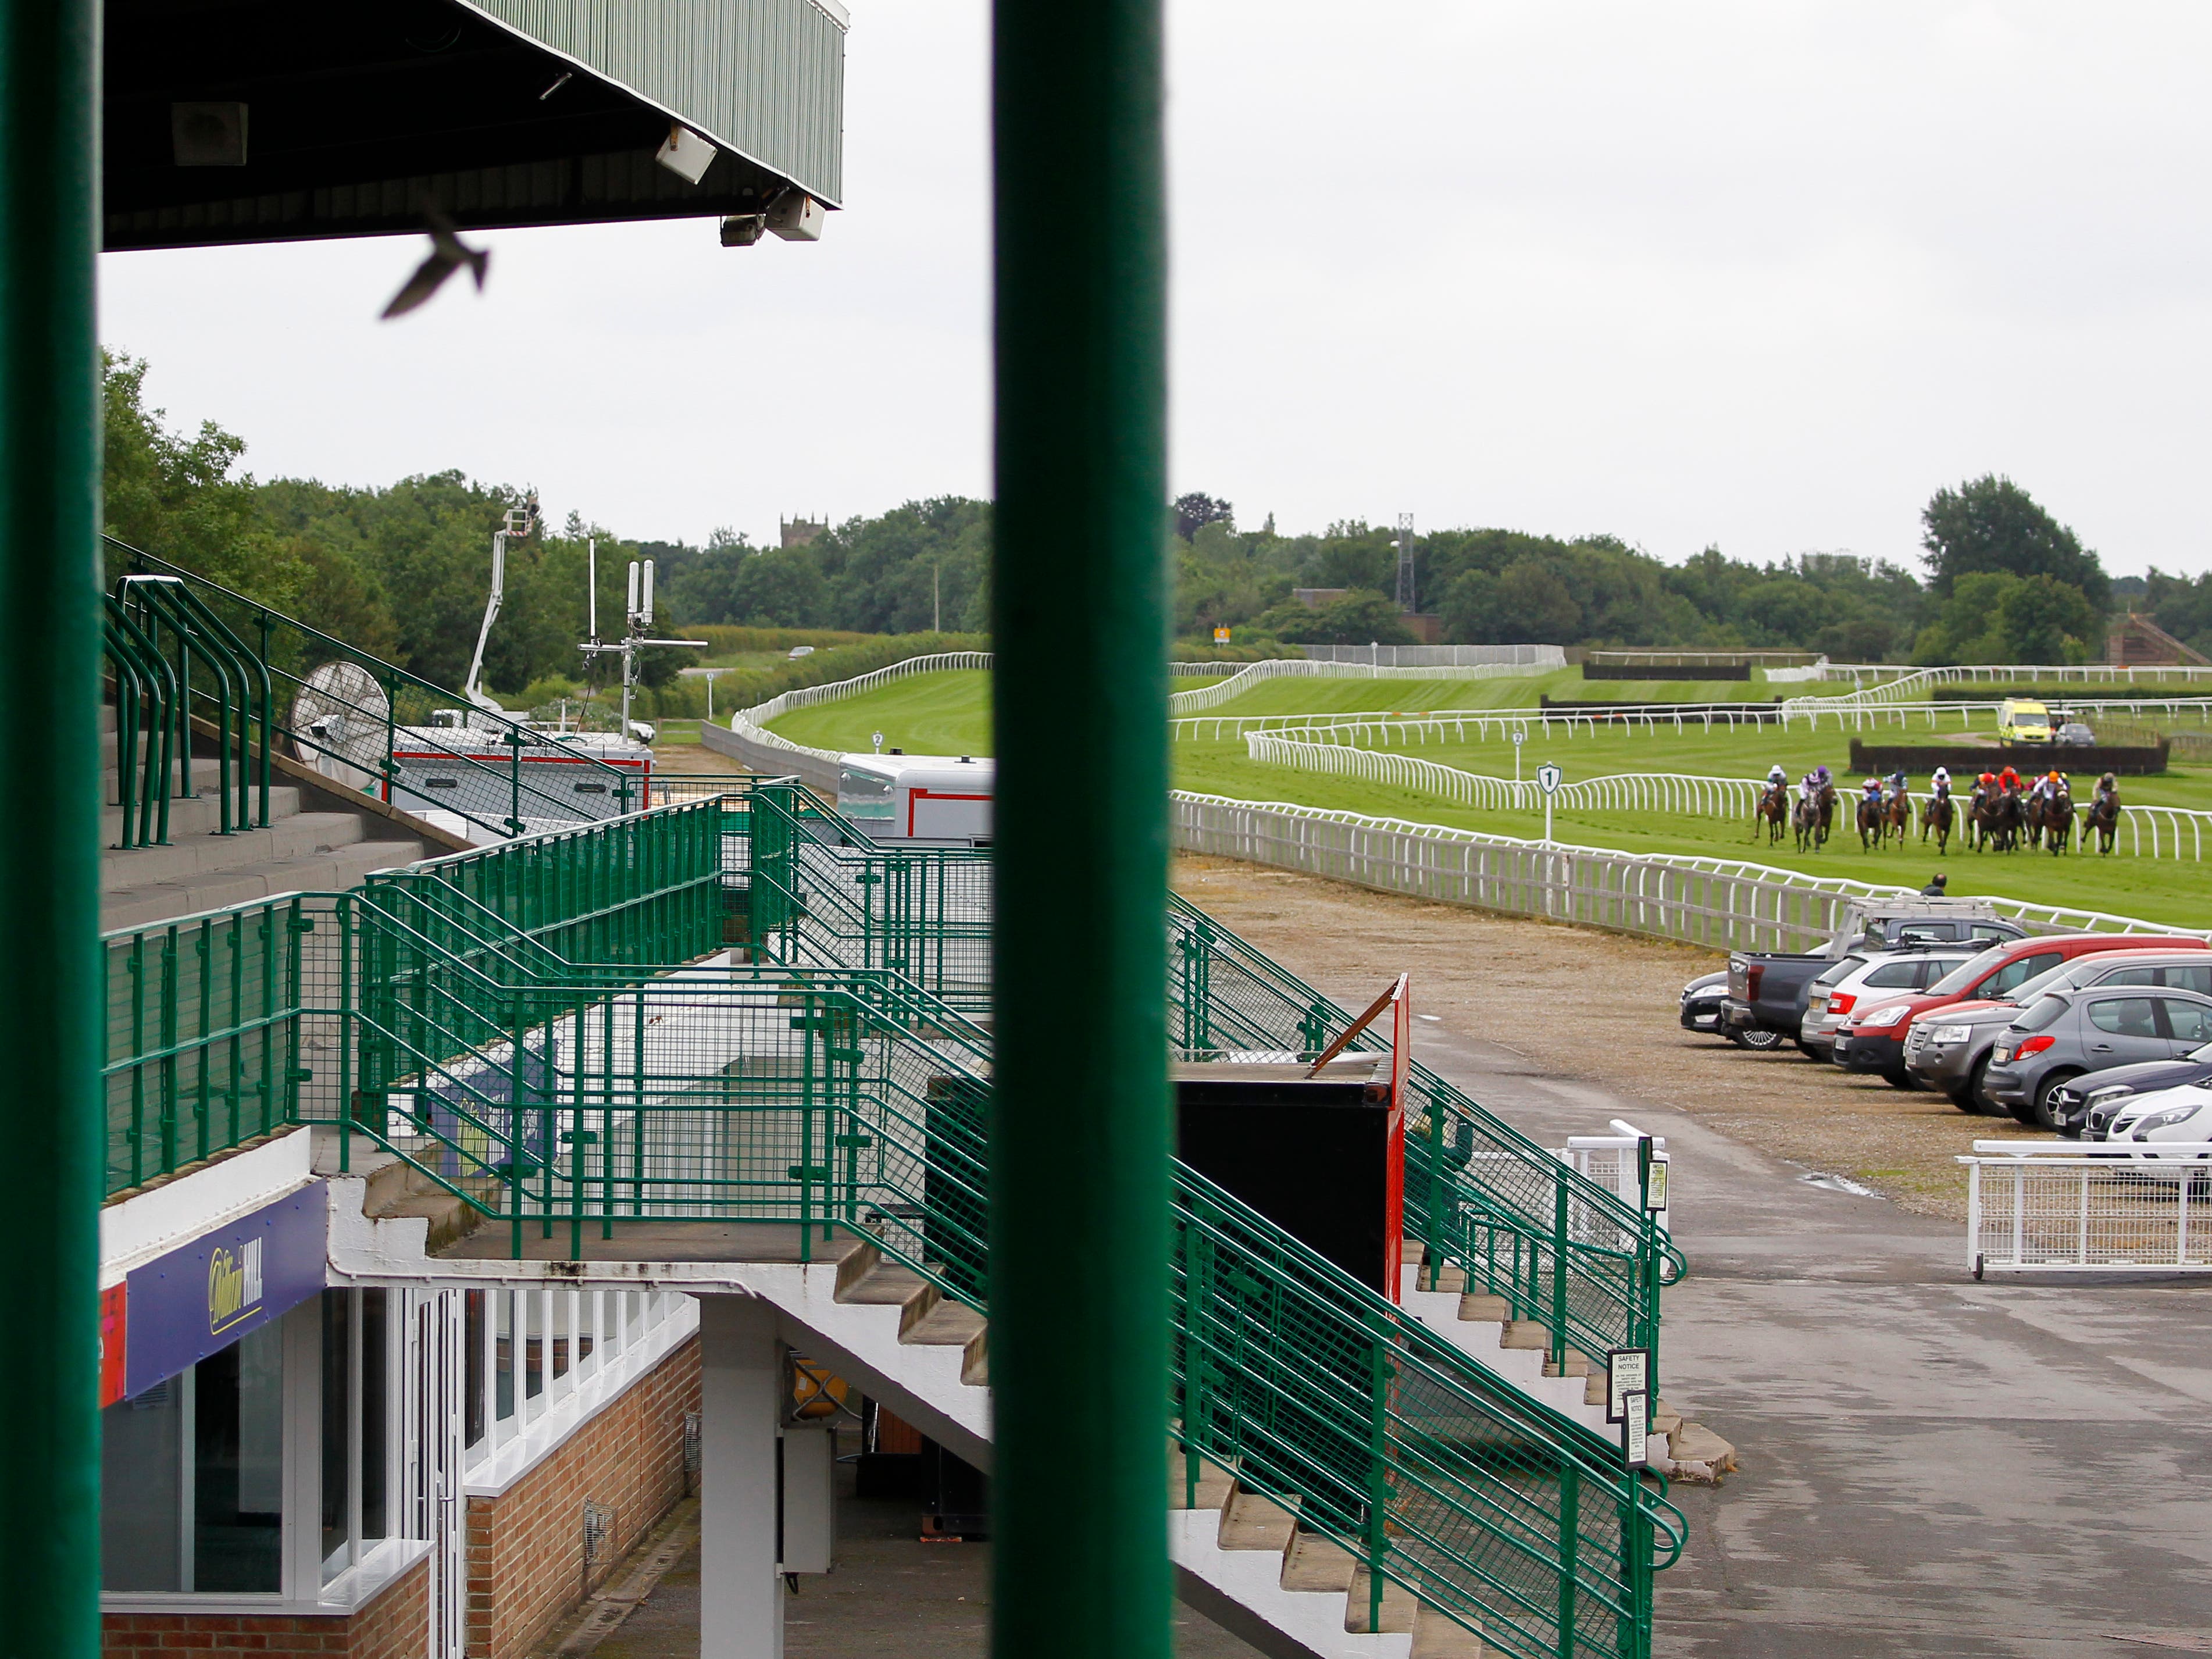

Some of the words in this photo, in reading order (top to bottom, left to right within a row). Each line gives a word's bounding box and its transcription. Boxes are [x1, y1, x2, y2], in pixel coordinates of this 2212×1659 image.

[875, 735, 880, 744] 2
[1515, 734, 1521, 742] 2
[1545, 770, 1552, 786] 1
[243, 1237, 263, 1307] HILL
